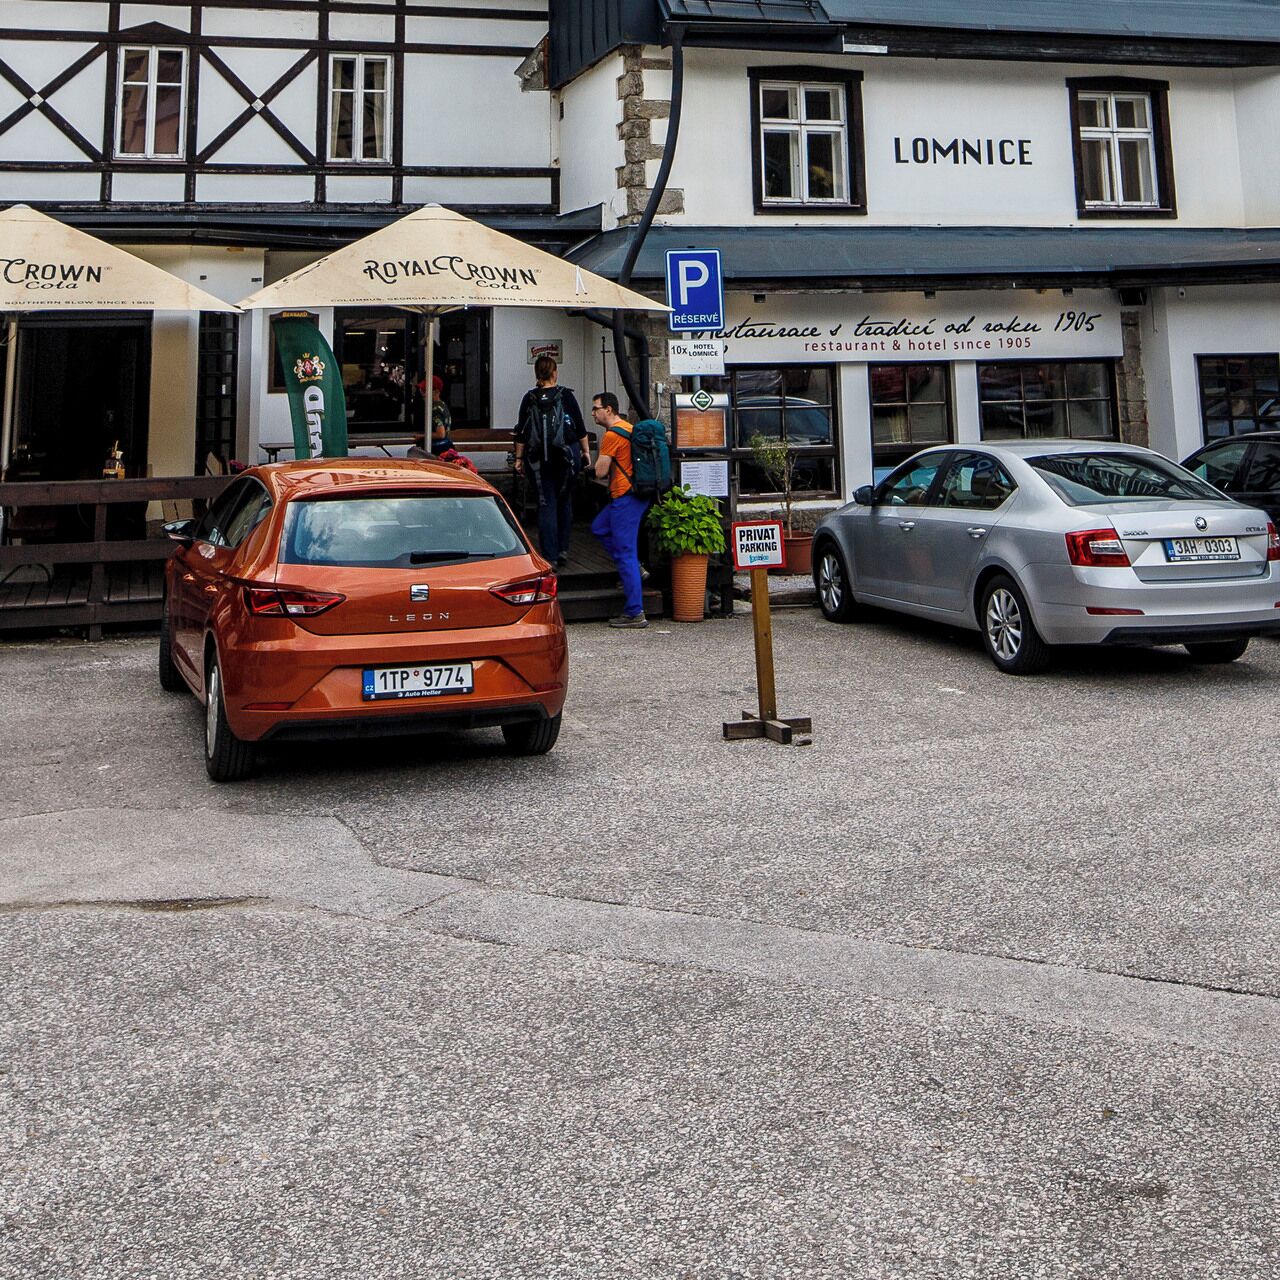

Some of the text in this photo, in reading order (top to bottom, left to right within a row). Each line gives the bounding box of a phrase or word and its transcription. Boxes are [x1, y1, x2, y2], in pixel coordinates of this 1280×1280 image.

[894, 137, 1032, 165] LOMNICE
[363, 260, 440, 284] ROYAL
[433, 256, 538, 286] CROWN
[25, 281, 78, 290] Cola
[476, 280, 522, 291] Cola
[678, 260, 709, 305] P
[674, 312, 719, 324] RÉSERVÉ
[830, 323, 842, 337] s
[854, 316, 936, 337] tradicí
[944, 316, 975, 333] od
[982, 316, 1041, 332] roku
[1054, 311, 1102, 332] 1905
[671, 345, 687, 355] 10x
[804, 337, 1031, 352] restaurant & hotel since 1905
[739, 528, 775, 542] PRIVAT
[740, 542, 777, 553] PARKING
[1175, 539, 1232, 554] 3AH 0303
[389, 612, 449, 622] LEON
[380, 667, 464, 690] 1TP 9774
